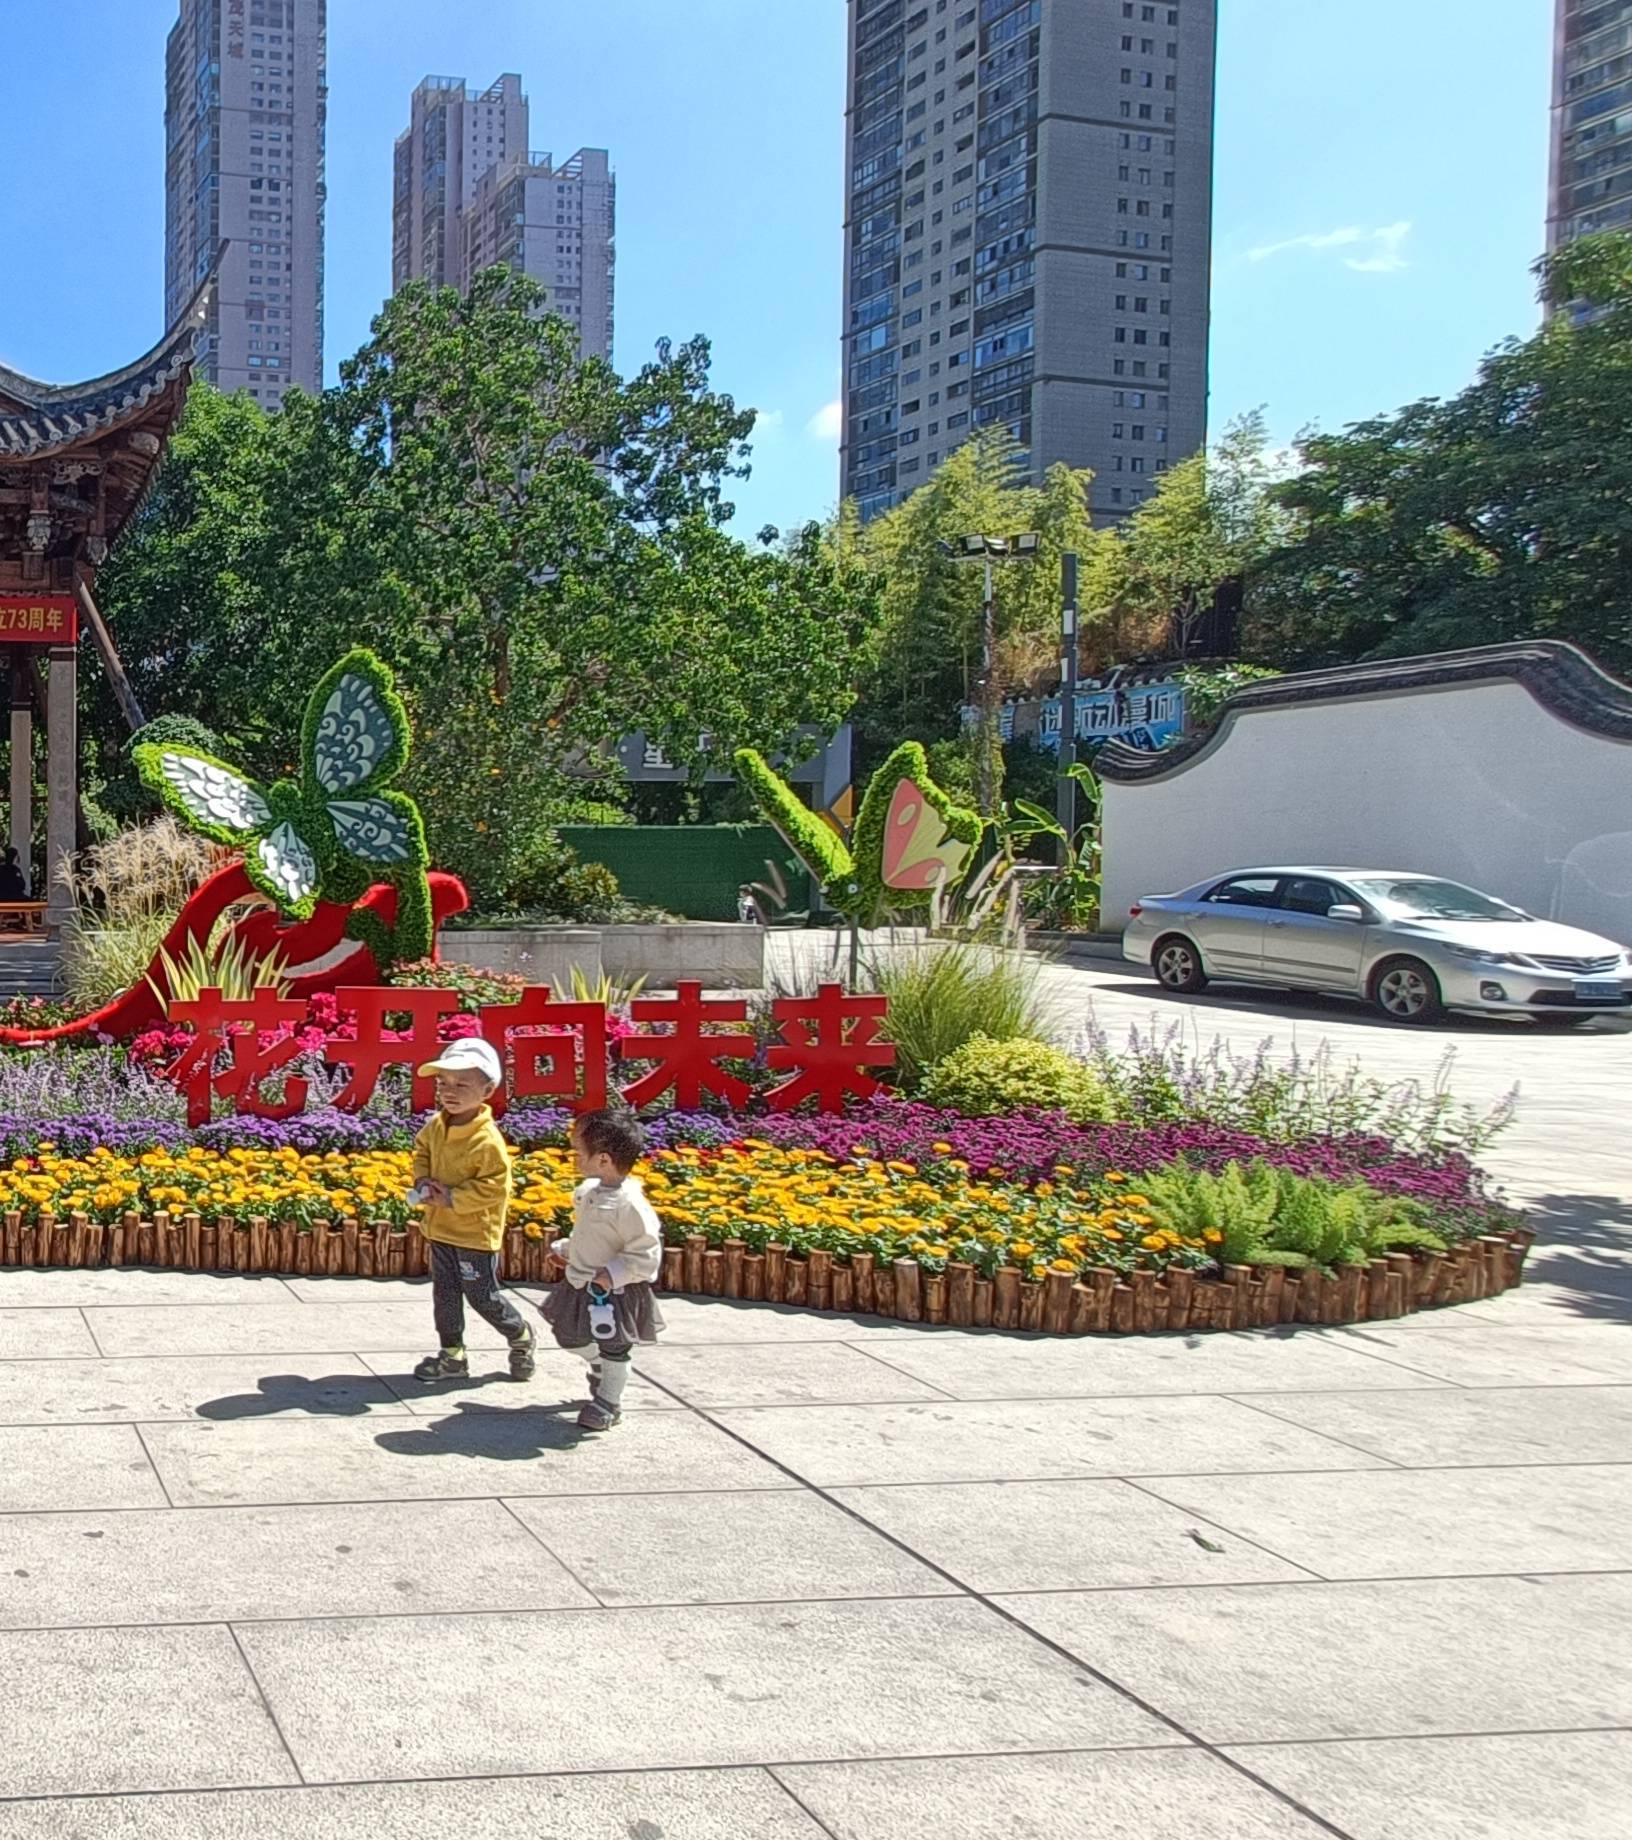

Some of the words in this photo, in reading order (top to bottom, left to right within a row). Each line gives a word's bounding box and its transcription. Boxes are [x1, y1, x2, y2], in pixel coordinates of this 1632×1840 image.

[167, 980, 897, 1127] 花开向未来
